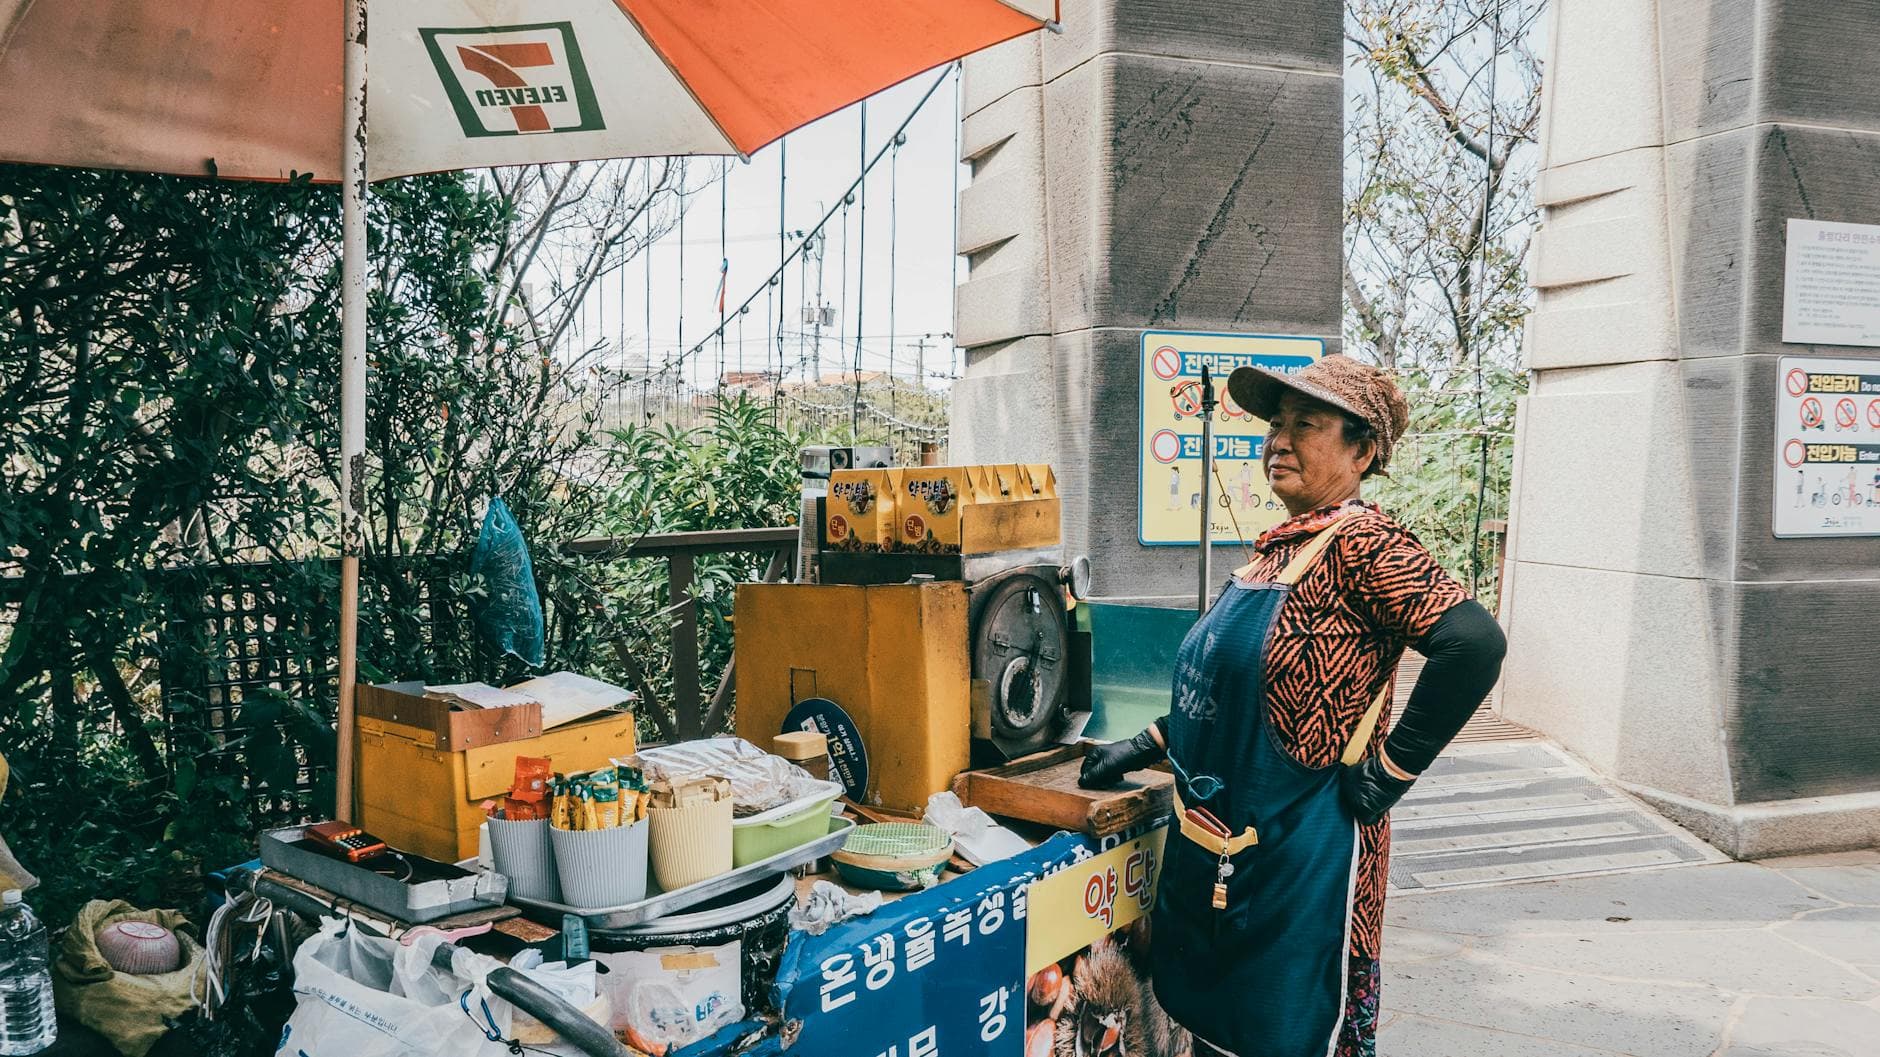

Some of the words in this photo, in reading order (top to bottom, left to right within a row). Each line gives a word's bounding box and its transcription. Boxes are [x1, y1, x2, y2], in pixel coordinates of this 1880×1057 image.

[1809, 374, 1860, 393] 진입금지
[1861, 381, 1872, 392] Do
[1184, 437, 1251, 457] 진가능
[1807, 444, 1857, 462] 진입가능
